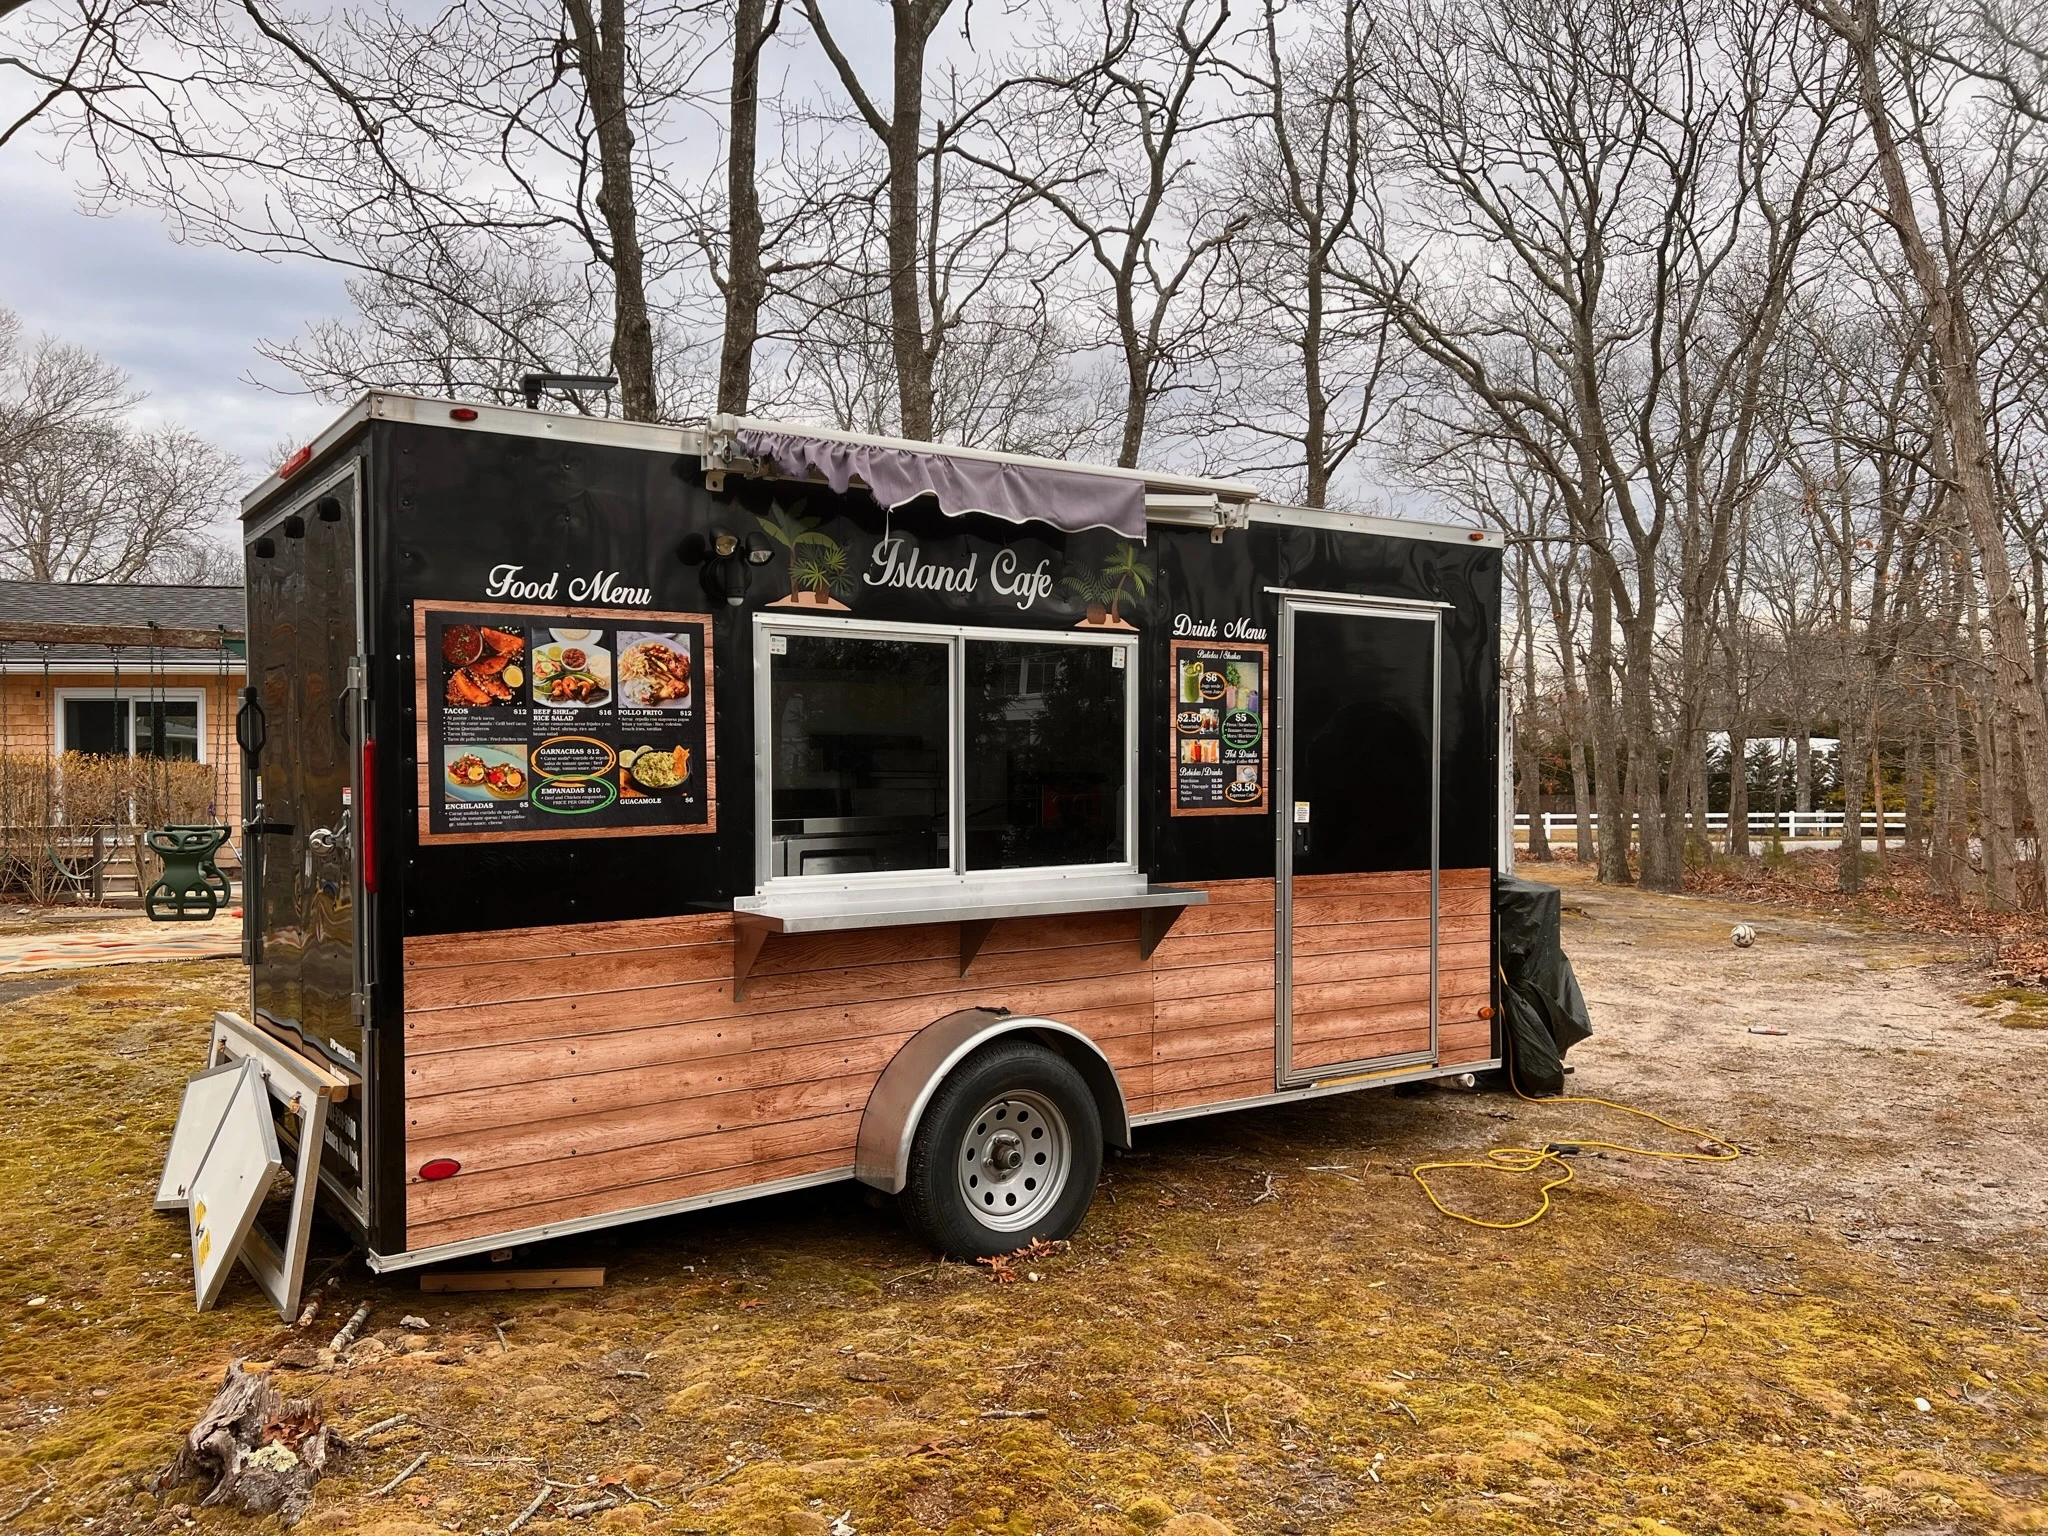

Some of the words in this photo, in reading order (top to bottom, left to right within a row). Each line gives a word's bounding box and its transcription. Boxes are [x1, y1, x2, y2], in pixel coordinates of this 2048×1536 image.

[863, 538, 978, 592] Island
[990, 549, 1053, 610] Cafe
[485, 564, 559, 600] Food
[568, 571, 652, 605] Menu
[1172, 614, 1218, 637] Drink
[1224, 617, 1267, 640] Menu
[1206, 673, 1217, 682] $6
[1178, 713, 1202, 722] $2.50
[1235, 713, 1247, 722] $5
[1231, 783, 1256, 792] $3.50
